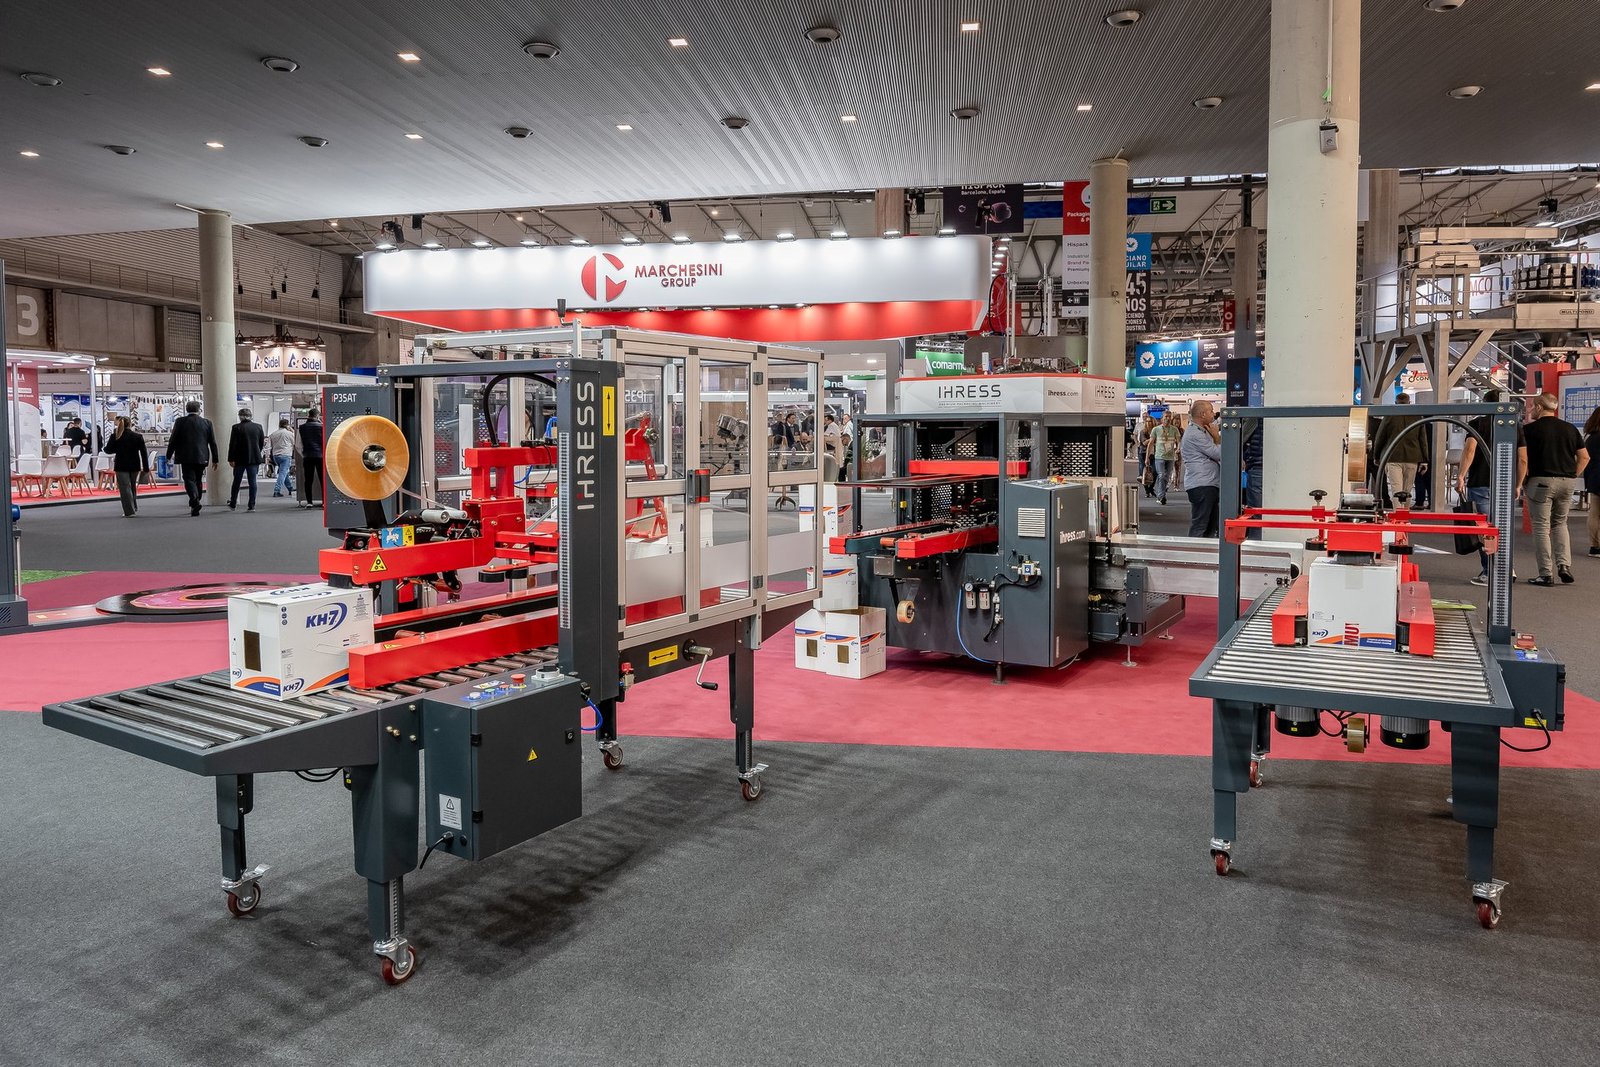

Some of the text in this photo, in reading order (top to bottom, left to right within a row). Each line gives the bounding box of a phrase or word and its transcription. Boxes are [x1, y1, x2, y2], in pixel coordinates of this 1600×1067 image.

[635, 264, 723, 278] MARCHESINI
[661, 277, 697, 288] GROUP
[17, 295, 39, 336] 3
[1158, 350, 1193, 359] LUCIANO
[264, 356, 281, 369] Sidel
[301, 357, 322, 370] Sidel
[1158, 359, 1192, 367] AGUILAR
[938, 384, 1002, 399] IHRESS
[1047, 389, 1079, 397] ihress.com
[1094, 385, 1116, 399] IHRESS
[576, 381, 595, 511] IHRESS
[1060, 530, 1086, 544] ihress.com
